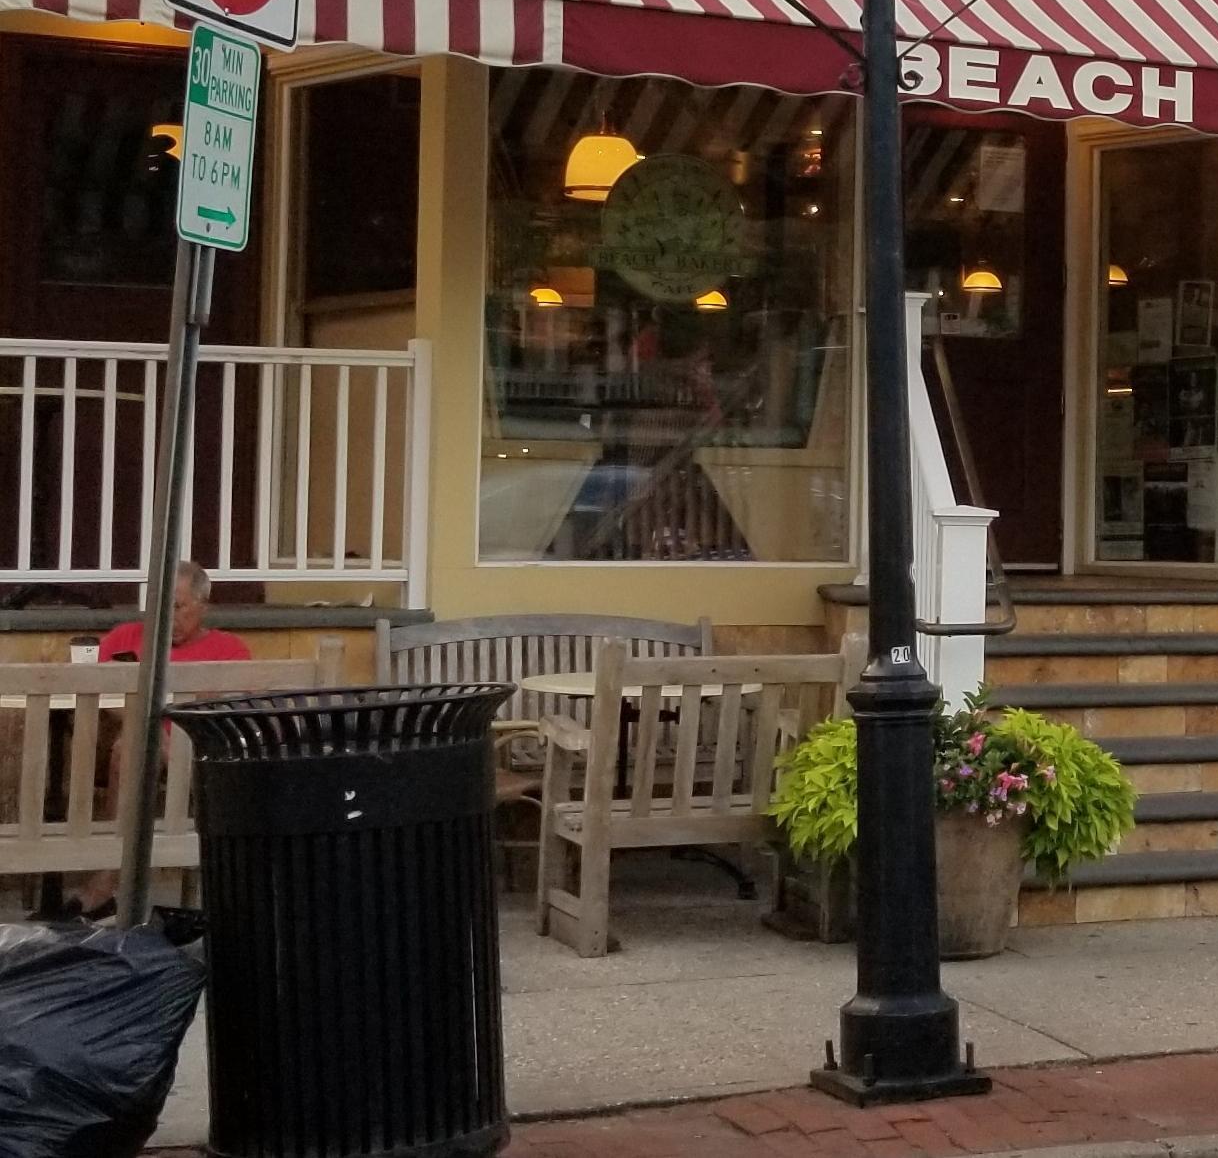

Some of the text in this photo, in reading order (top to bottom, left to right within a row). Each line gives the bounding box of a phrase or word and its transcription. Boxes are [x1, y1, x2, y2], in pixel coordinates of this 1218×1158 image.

[192, 46, 244, 88] 30 MIN
[896, 41, 1194, 123] BEACH
[209, 75, 252, 112] PARKING
[192, 153, 207, 182] TO
[893, 647, 910, 663] 20
